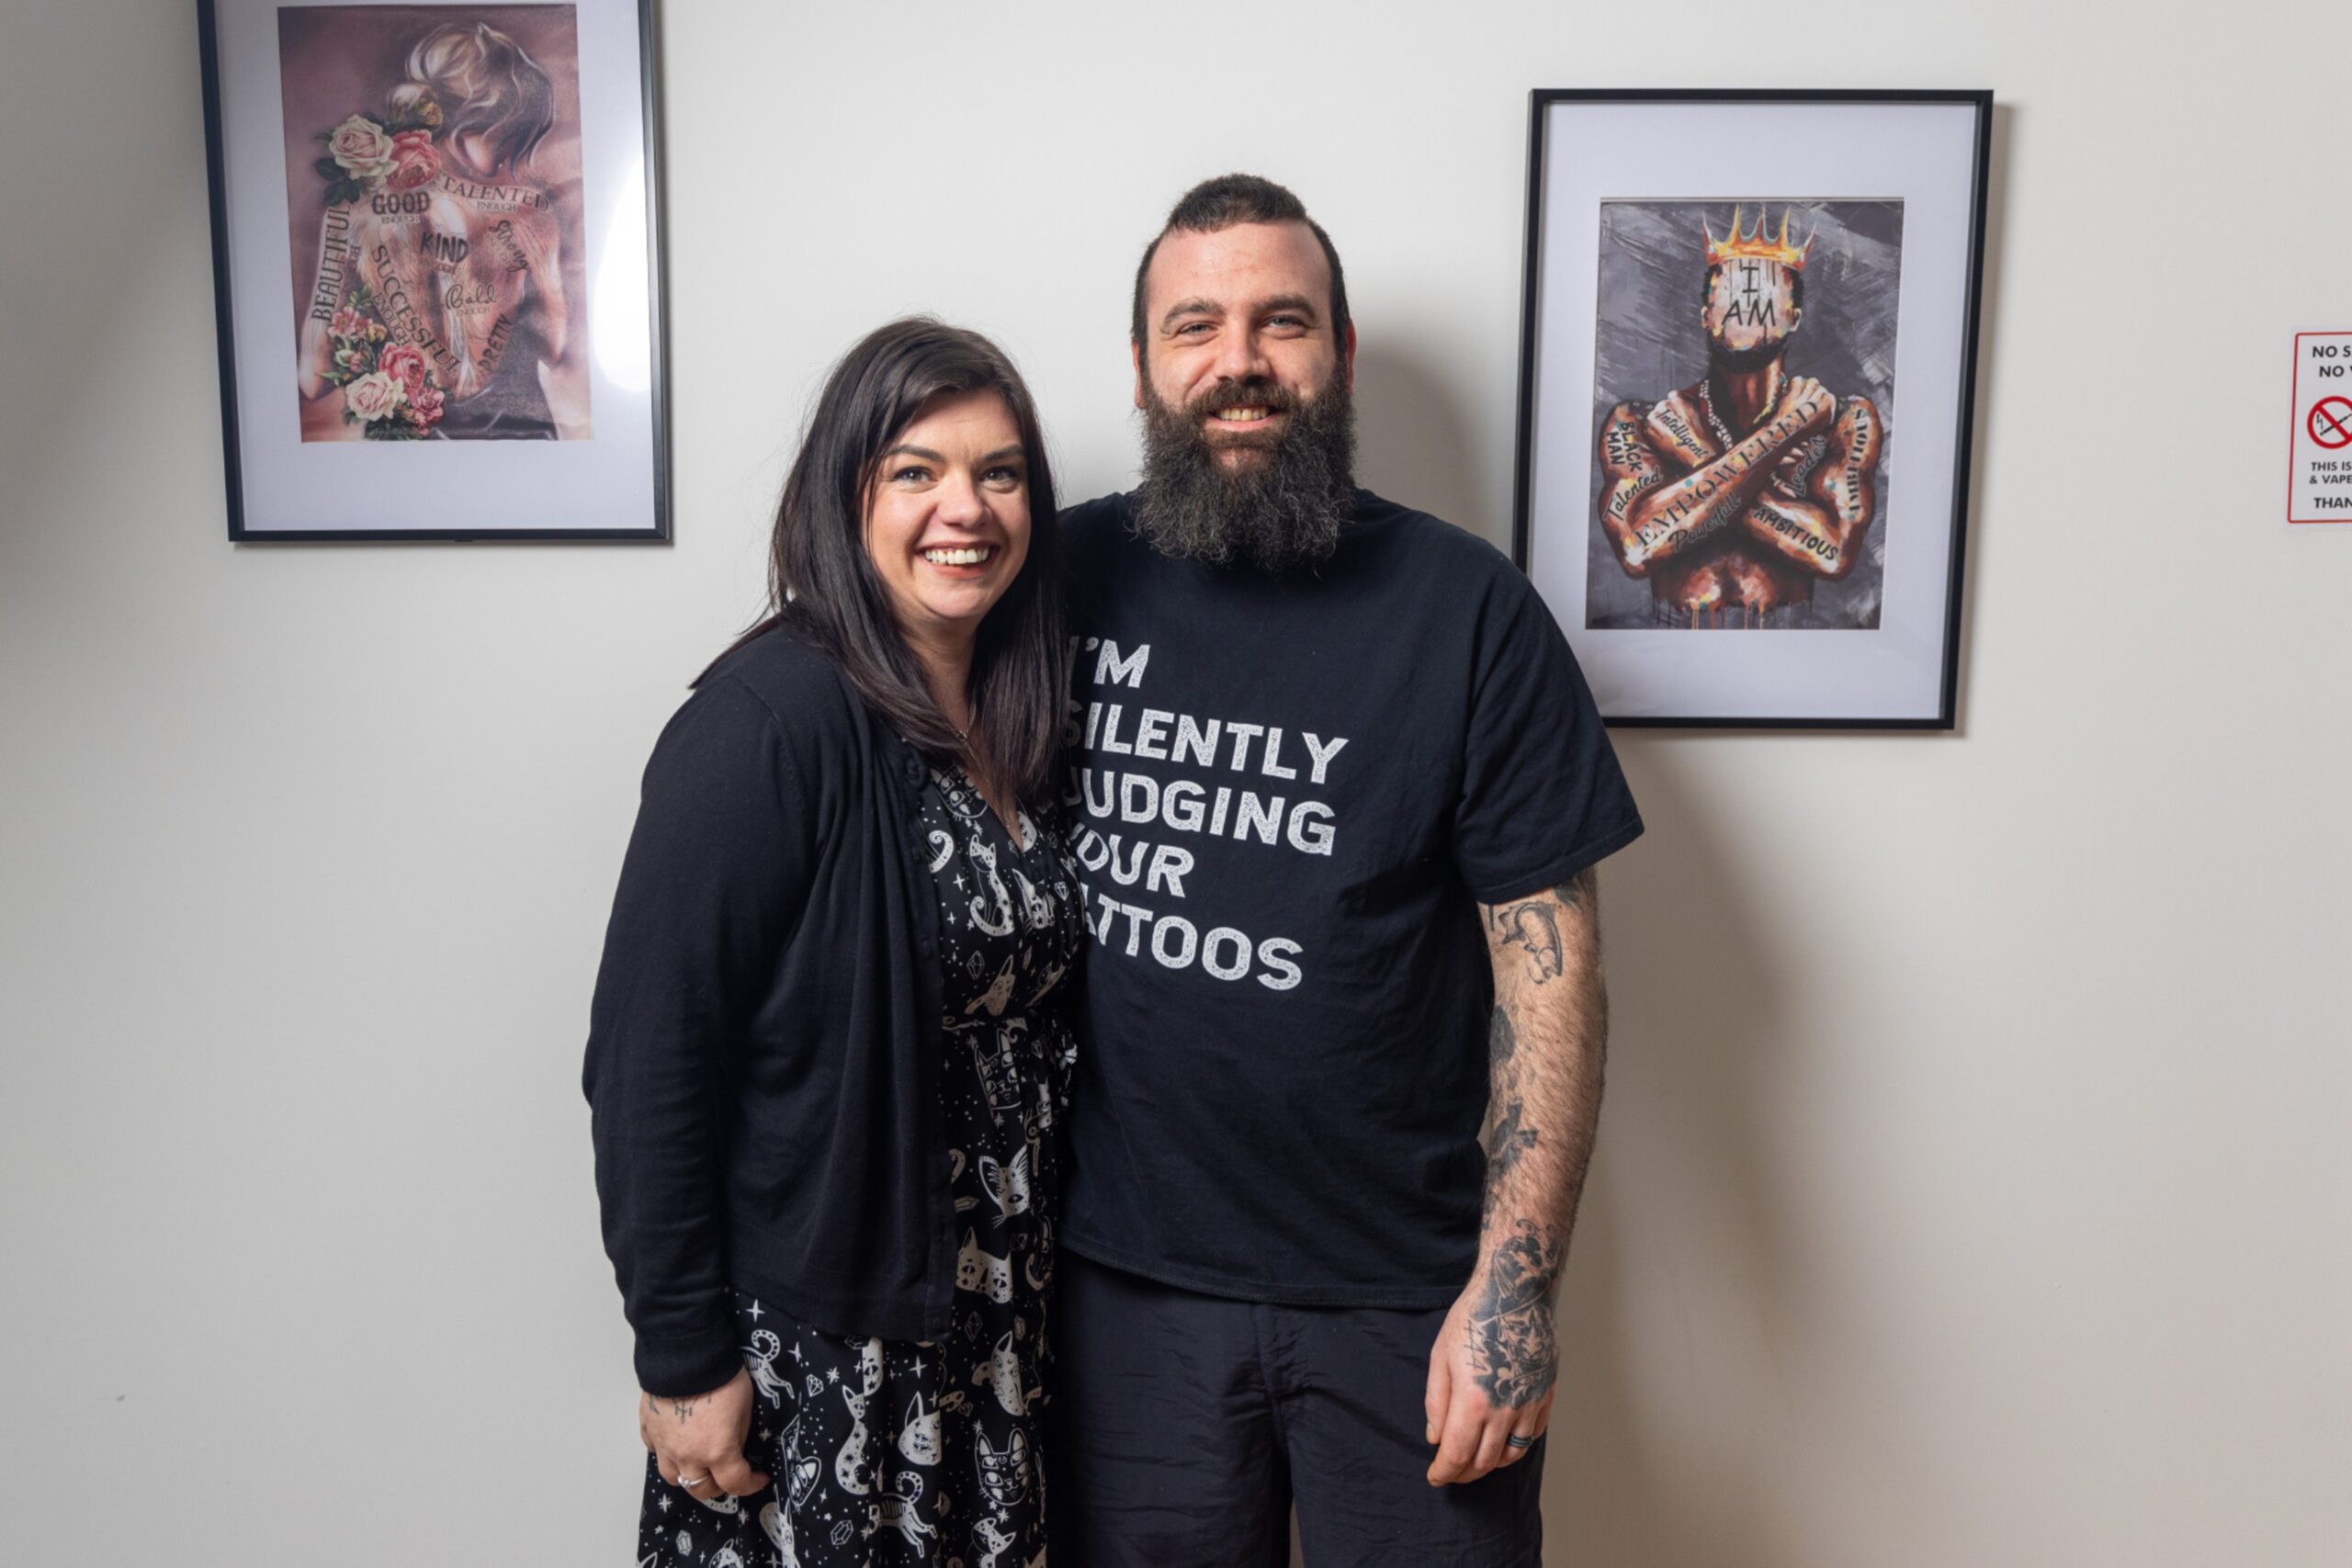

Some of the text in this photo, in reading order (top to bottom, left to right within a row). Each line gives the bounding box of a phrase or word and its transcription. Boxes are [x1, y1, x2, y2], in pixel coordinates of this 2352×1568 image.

[371, 191, 430, 215] GOOD
[442, 174, 549, 211] TALENTED
[311, 204, 351, 321] BEAUTIFUL
[420, 231, 469, 263] KIND
[446, 283, 497, 310] Bold
[1742, 266, 1759, 293] I
[371, 244, 461, 372] SUCCESSFUL
[1721, 299, 1776, 326] AM
[478, 313, 513, 372] PRETTY
[2312, 345, 2337, 357] NO
[2318, 366, 2345, 378] NO
[1606, 431, 1626, 466] MAN
[1620, 422, 1643, 472] BLACK
[1655, 409, 1709, 459] Intelligent
[1635, 401, 1818, 547] EMPOWERED
[1846, 409, 1868, 513] AMBITIOUS
[2311, 461, 2337, 471] THIS
[1602, 466, 1662, 521] Talented
[2309, 475, 2317, 485] &
[1753, 507, 1839, 561] AMBITIOUS
